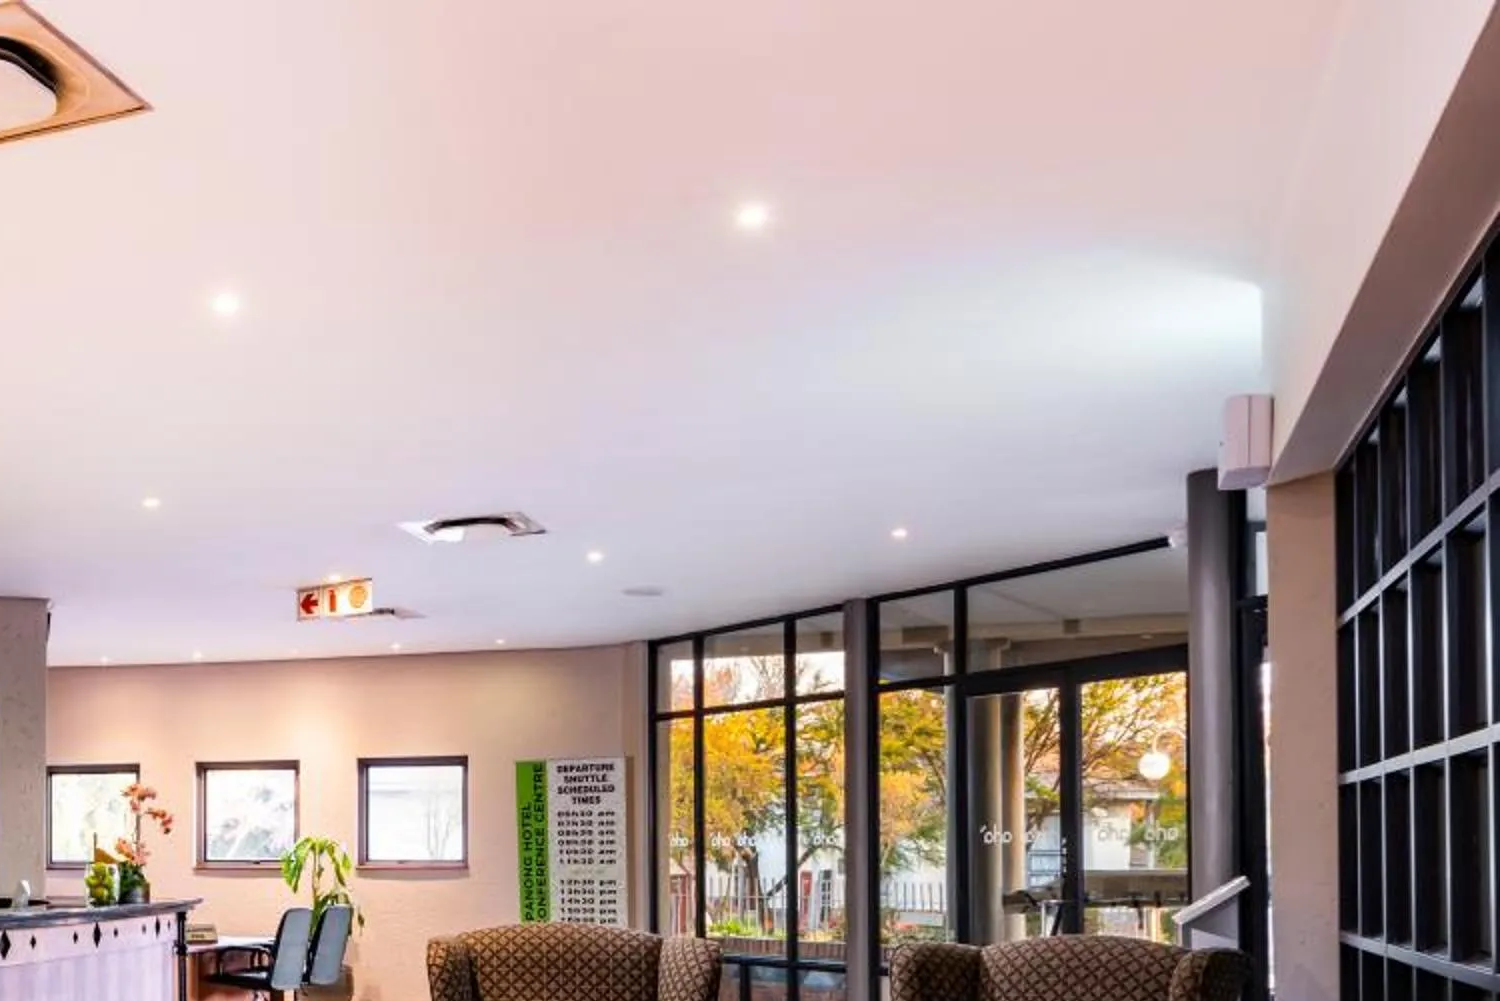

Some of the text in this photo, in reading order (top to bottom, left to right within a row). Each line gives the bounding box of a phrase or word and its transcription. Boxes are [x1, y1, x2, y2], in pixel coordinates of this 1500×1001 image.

[557, 764, 615, 773] DEPARTURE
[564, 774, 608, 783] SHUTTLE
[533, 763, 545, 822] CENTRE
[557, 785, 615, 794] SCHEDULED
[572, 796, 601, 804] TIMES
[521, 802, 532, 847] HOTEL
